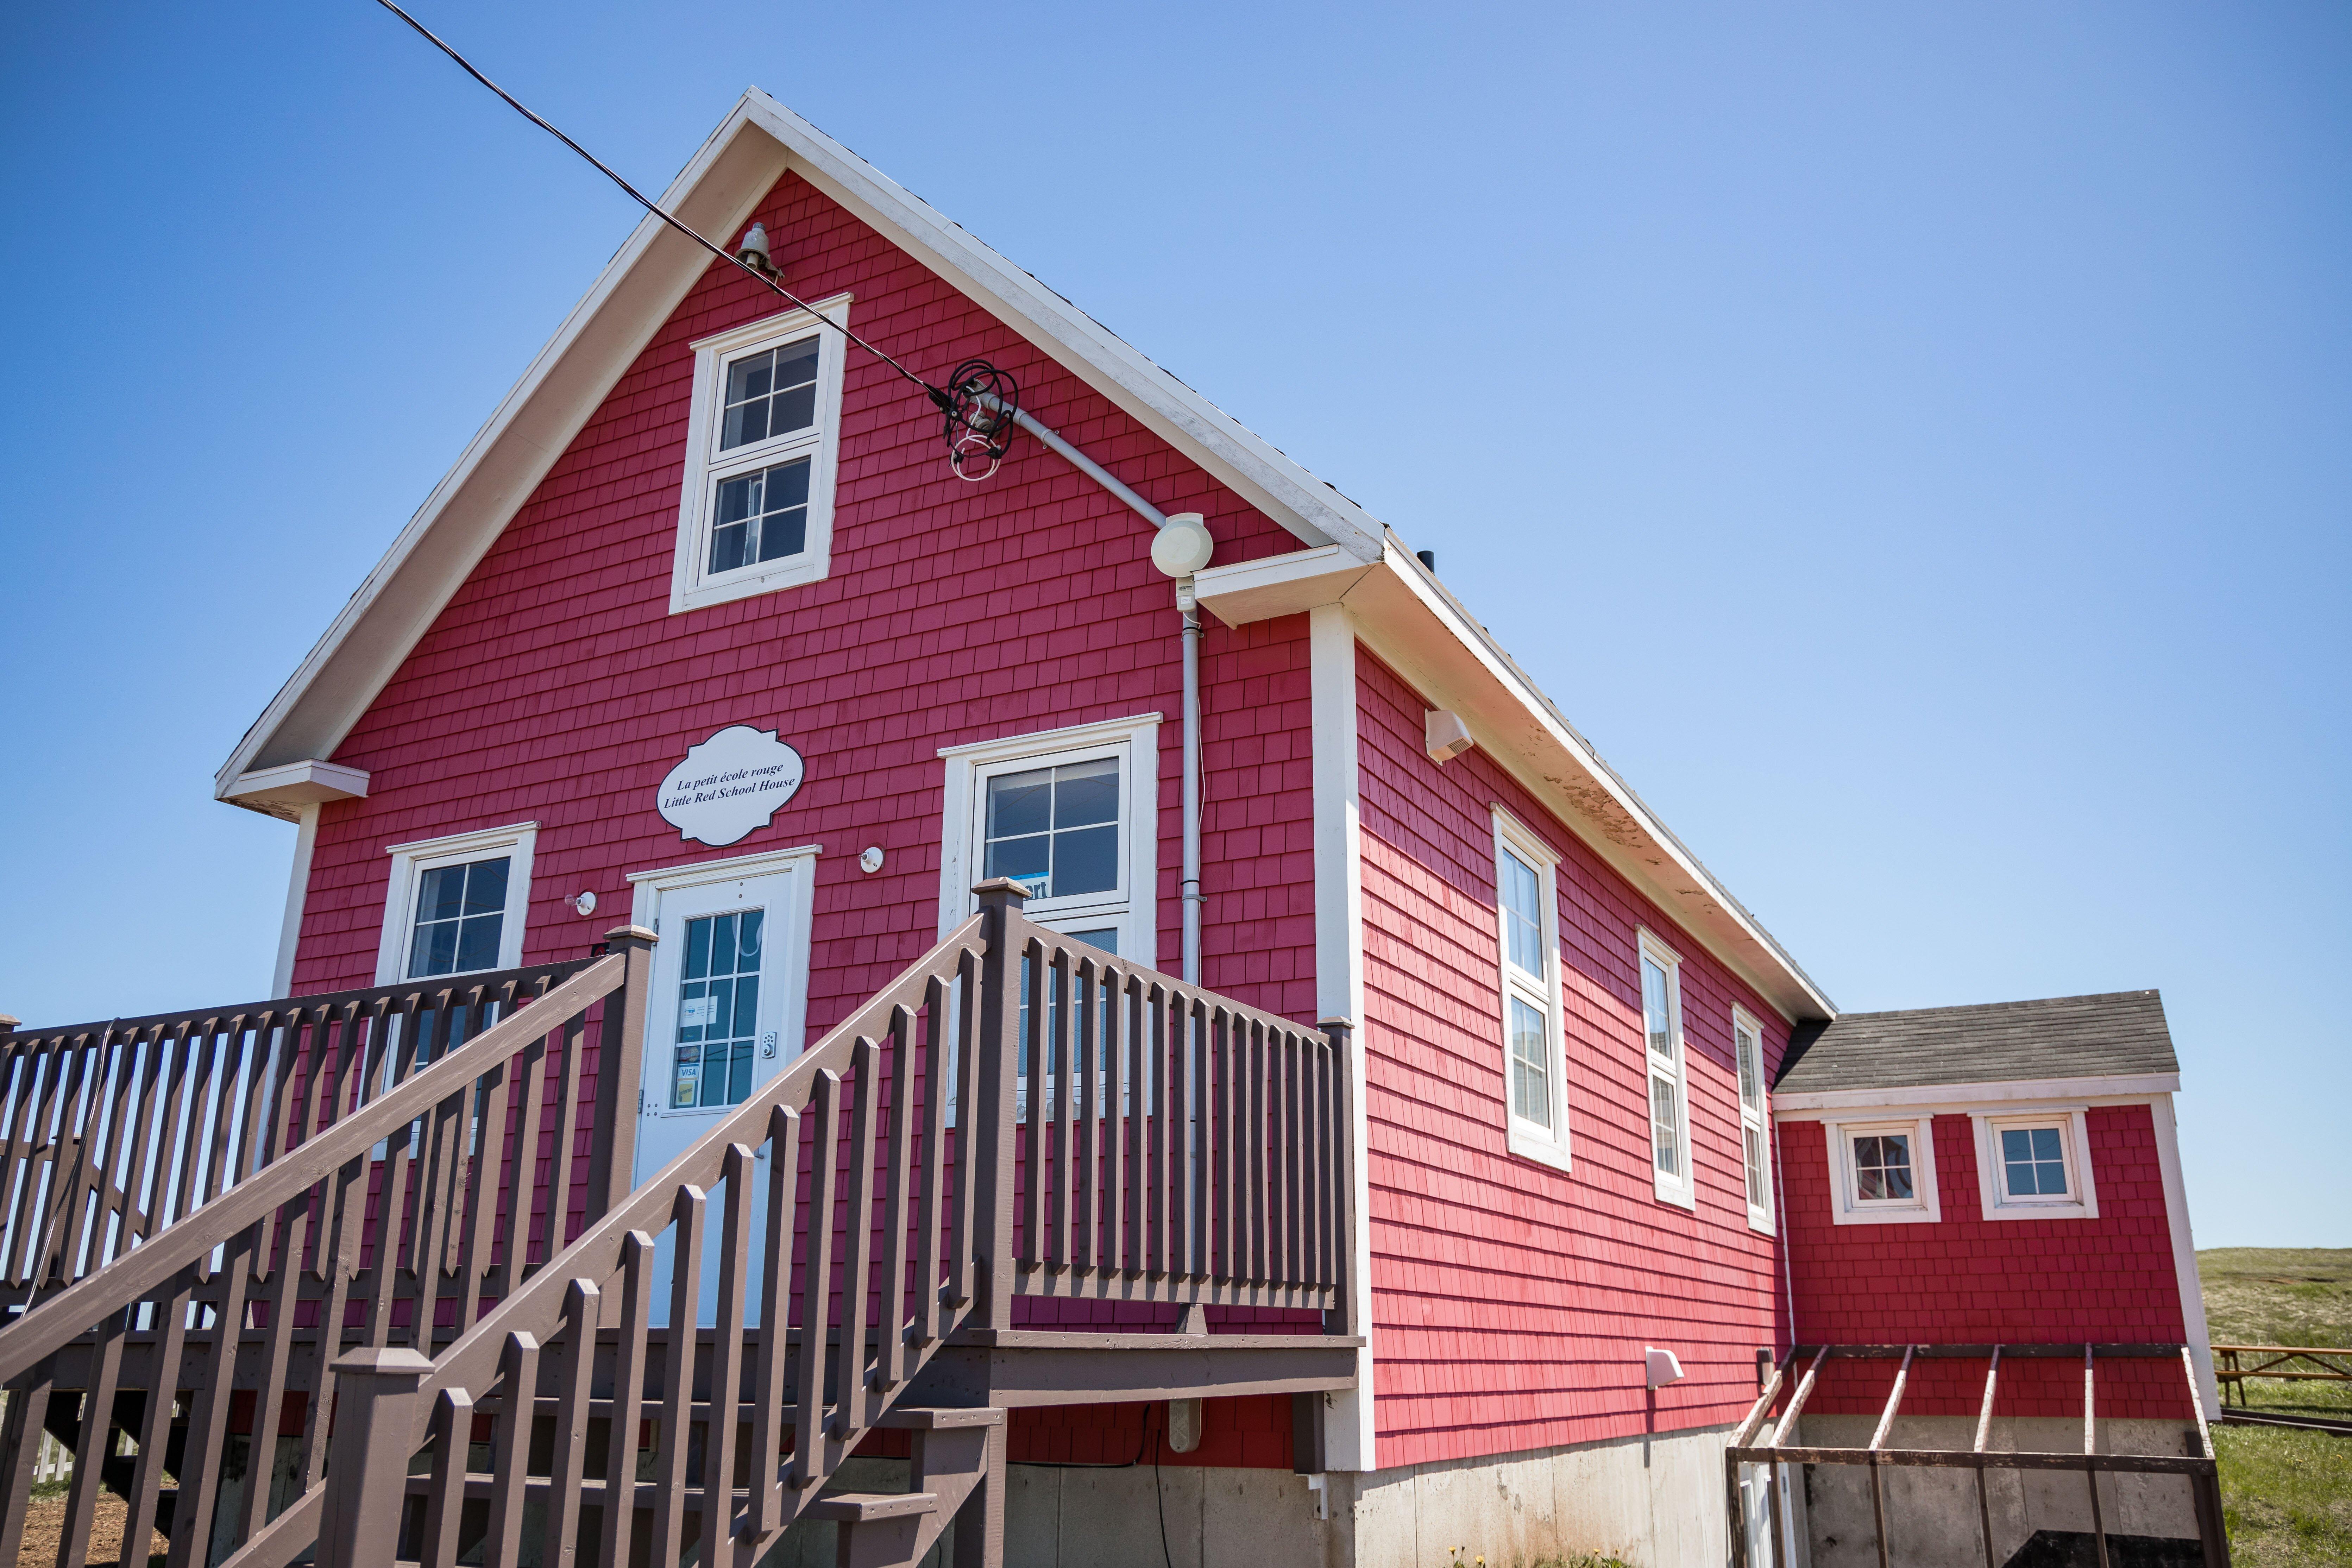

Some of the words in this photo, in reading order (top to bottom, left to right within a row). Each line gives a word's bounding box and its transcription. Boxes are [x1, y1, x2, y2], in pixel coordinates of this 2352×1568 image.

[677, 780, 691, 791] La
[692, 774, 718, 790] petit
[720, 769, 748, 782] école
[751, 764, 784, 777] rouge
[664, 795, 692, 808] Little
[694, 790, 716, 803] Red
[717, 782, 756, 799] School
[758, 778, 795, 792] House
[1024, 881, 1047, 900] ert
